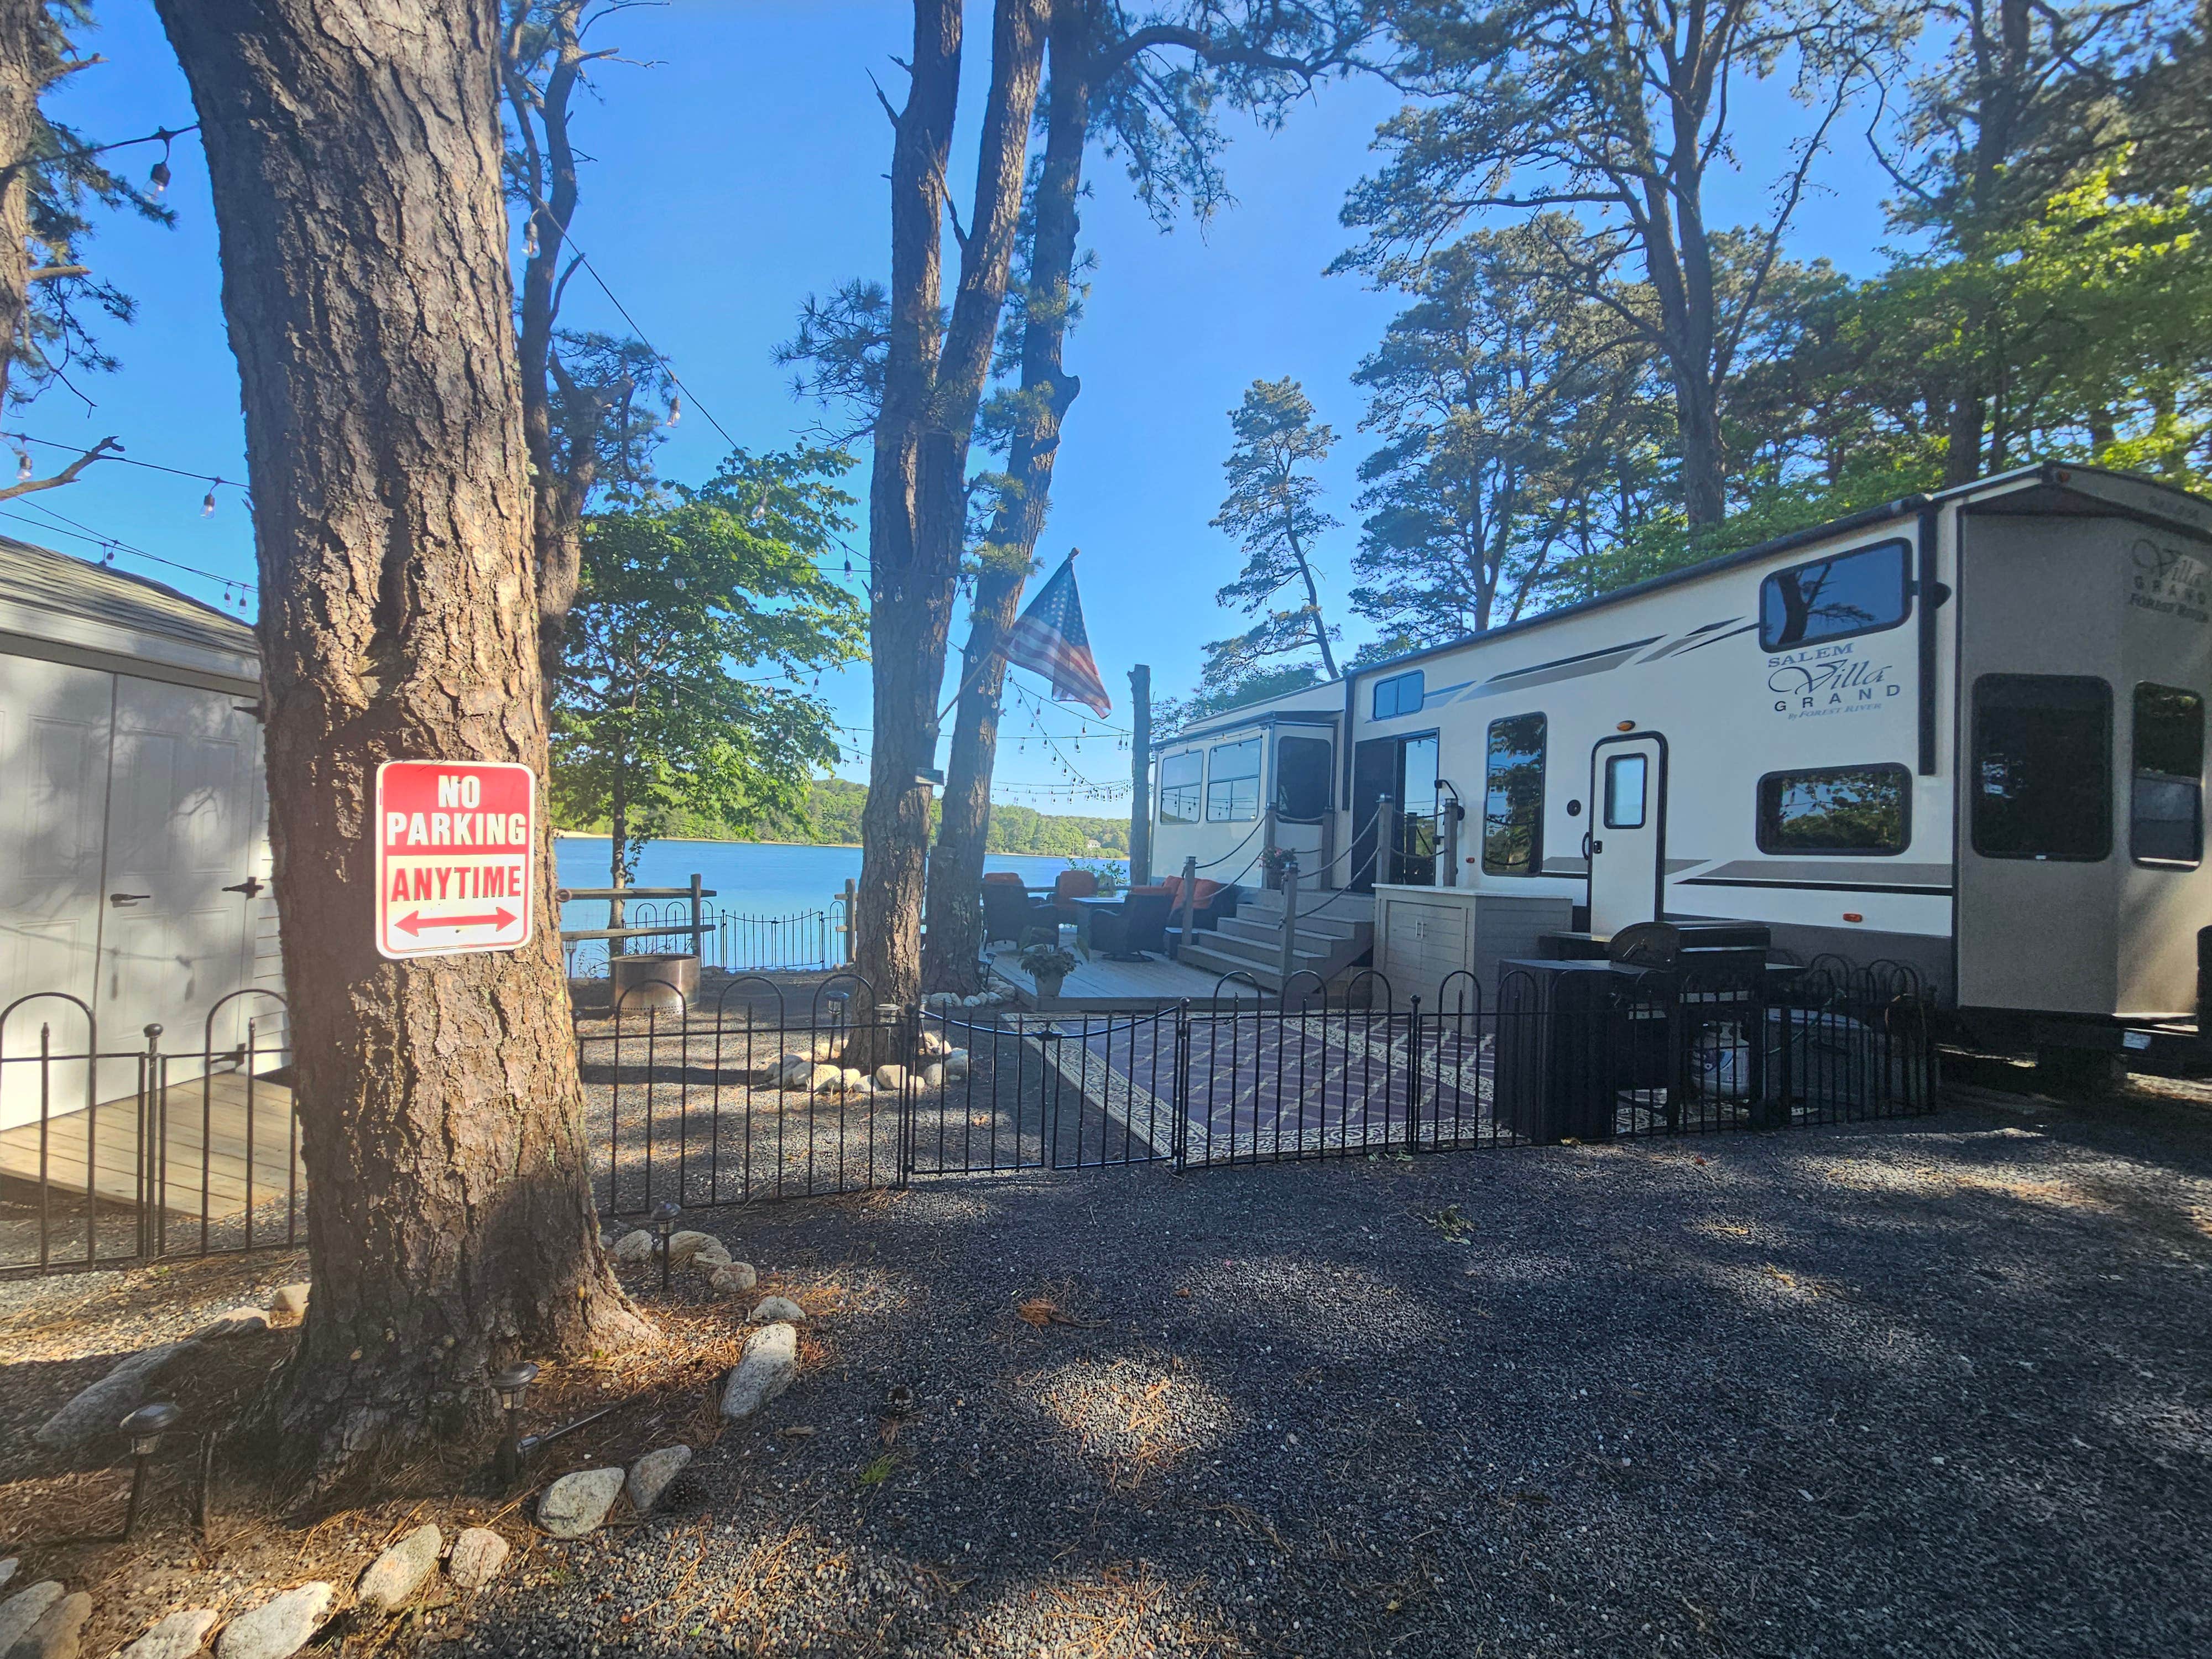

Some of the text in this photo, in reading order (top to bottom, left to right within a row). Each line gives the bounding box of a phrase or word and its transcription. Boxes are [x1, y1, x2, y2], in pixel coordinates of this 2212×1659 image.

[1768, 643, 1854, 667] SALEM
[1768, 659, 1892, 695] Villa
[1775, 685, 1900, 712] GRAND
[1799, 708, 1843, 718] FOREST
[1844, 703, 1882, 713] RIVER
[438, 775, 480, 808] NO
[387, 812, 526, 846] PARKING
[390, 866, 521, 902] ANYTIME
